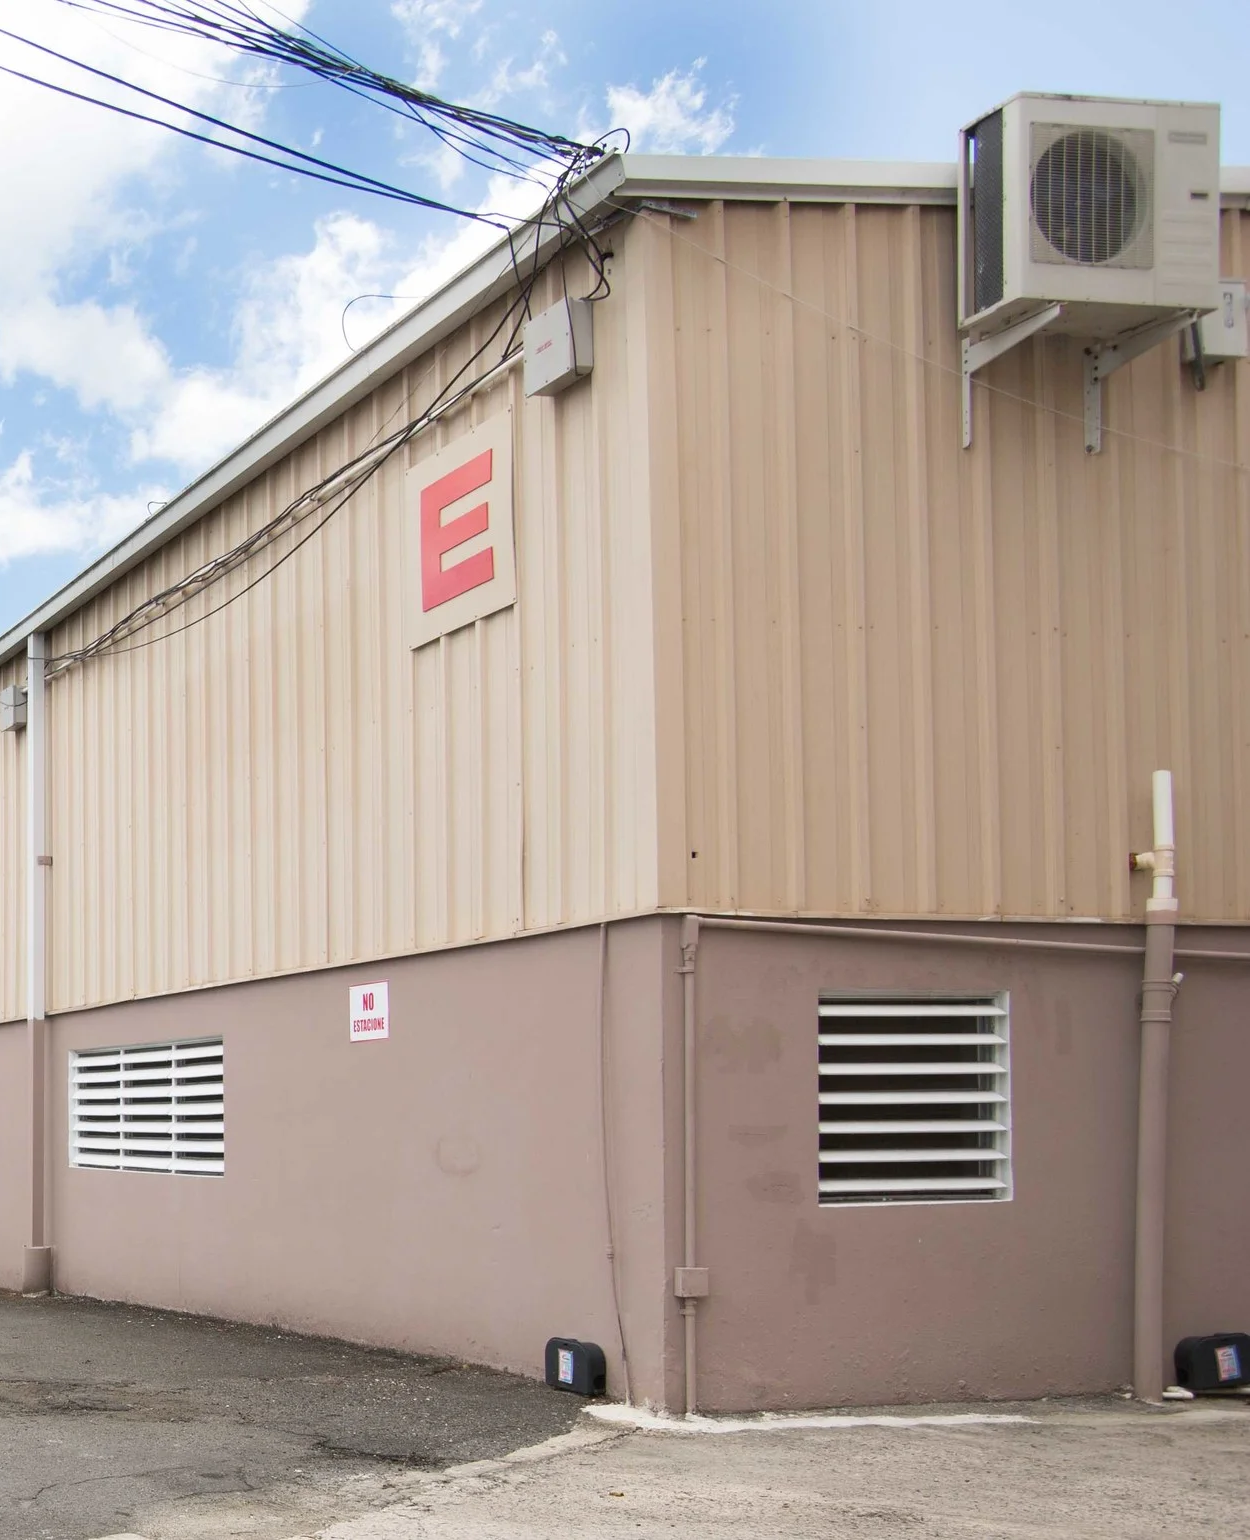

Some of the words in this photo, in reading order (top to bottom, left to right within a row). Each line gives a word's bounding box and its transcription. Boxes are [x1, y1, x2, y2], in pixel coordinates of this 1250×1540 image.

[421, 448, 494, 613] E
[362, 992, 375, 1011] NO
[353, 1017, 385, 1033] ESTACIONE
